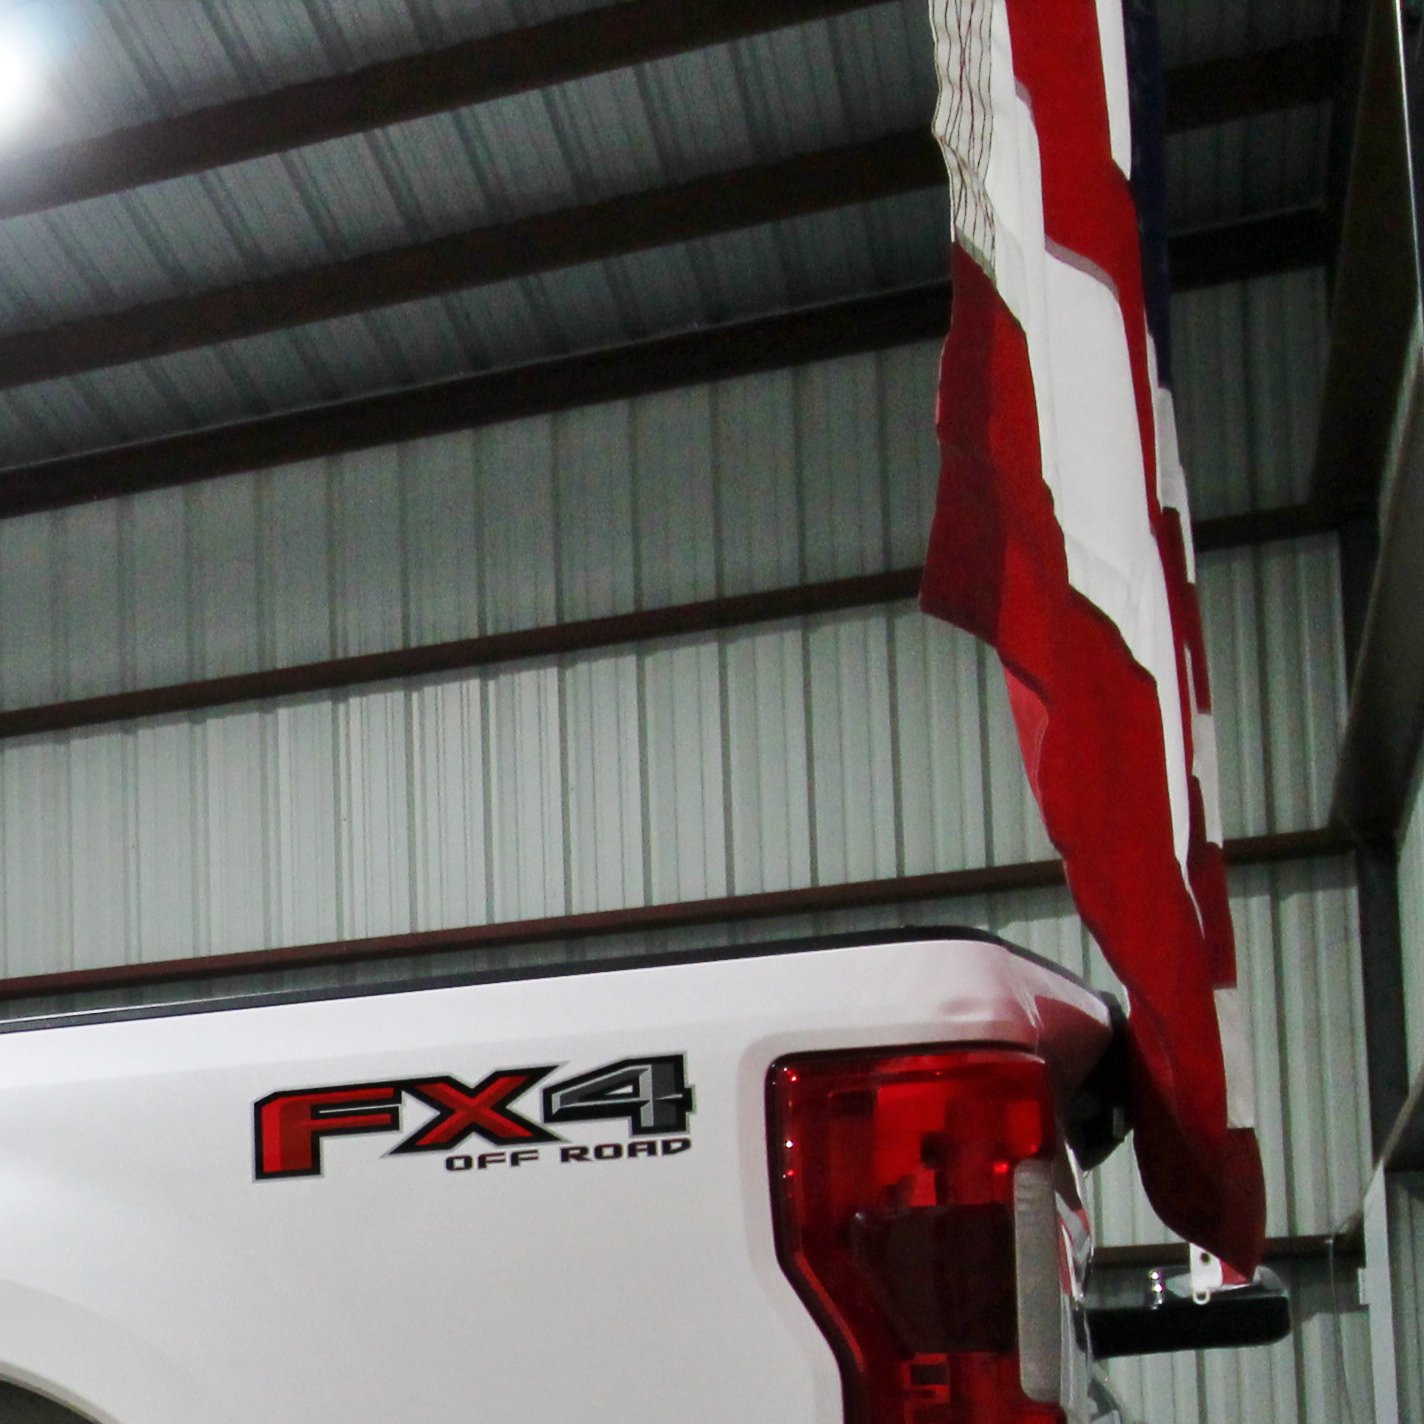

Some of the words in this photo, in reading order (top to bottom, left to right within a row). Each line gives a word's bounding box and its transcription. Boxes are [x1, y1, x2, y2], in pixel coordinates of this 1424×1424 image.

[253, 1050, 697, 1183] FX4
[444, 1148, 539, 1172] OFF
[560, 1137, 692, 1164] ROAD
